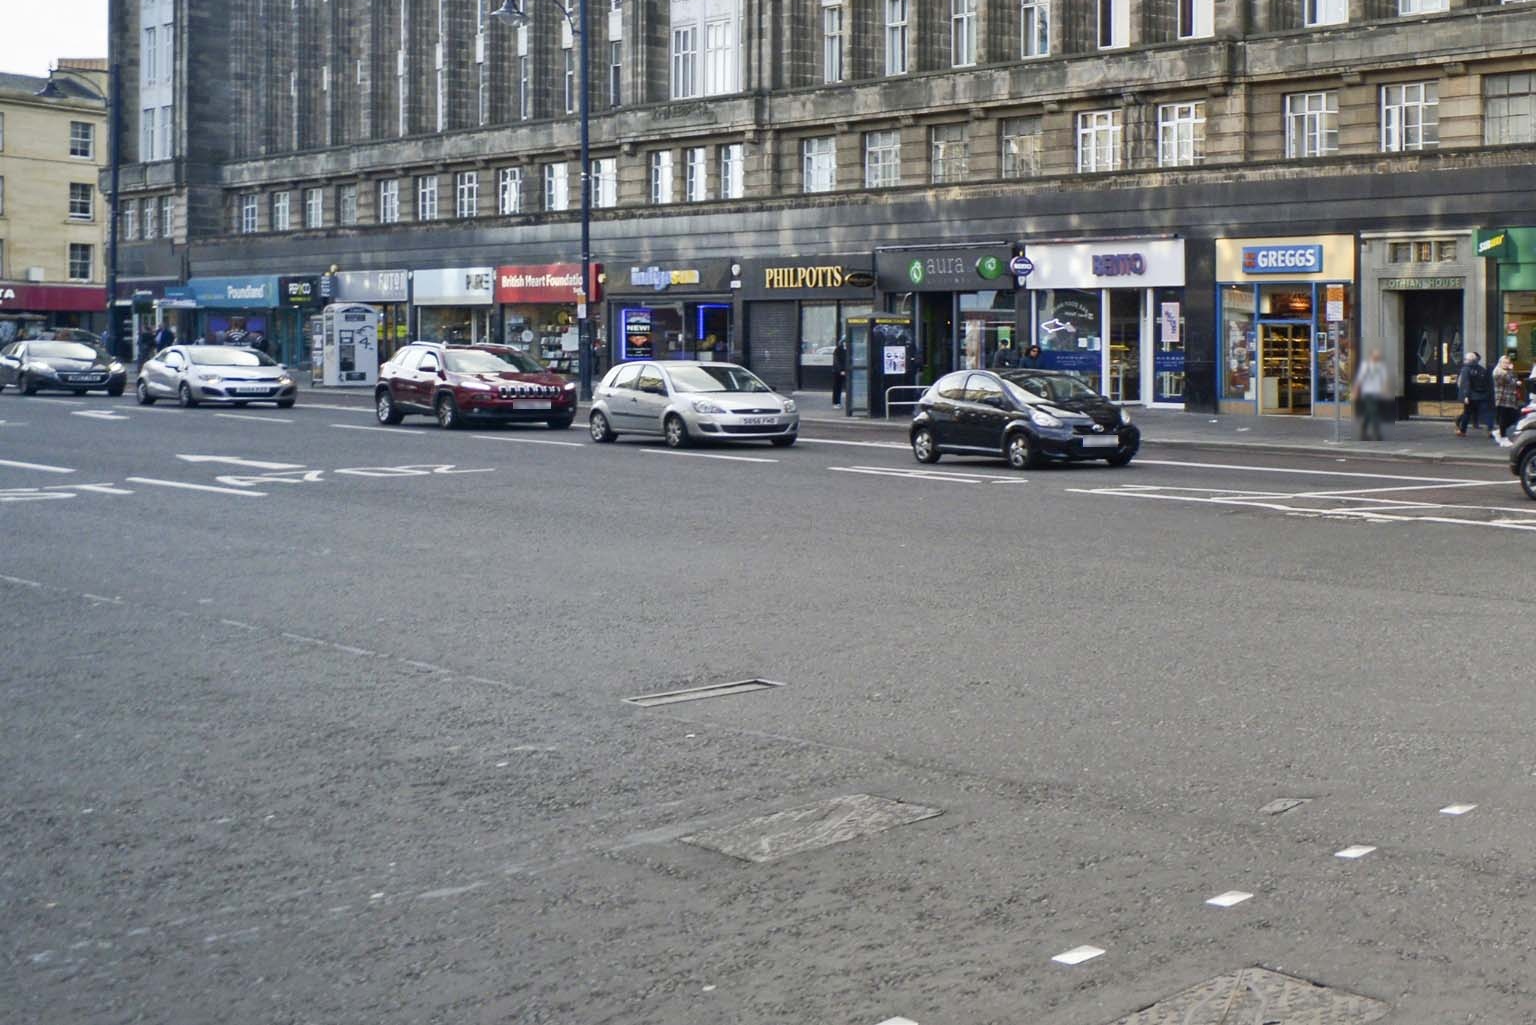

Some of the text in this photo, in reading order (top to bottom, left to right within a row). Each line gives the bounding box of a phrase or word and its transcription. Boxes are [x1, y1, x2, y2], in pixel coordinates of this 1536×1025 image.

[926, 257, 964, 275] aura
[1257, 249, 1316, 268] GREGGS
[501, 274, 583, 288] British Heart Foundatio
[765, 265, 843, 288] PHILPOTTS
[1387, 278, 1422, 289] OTHIAN
